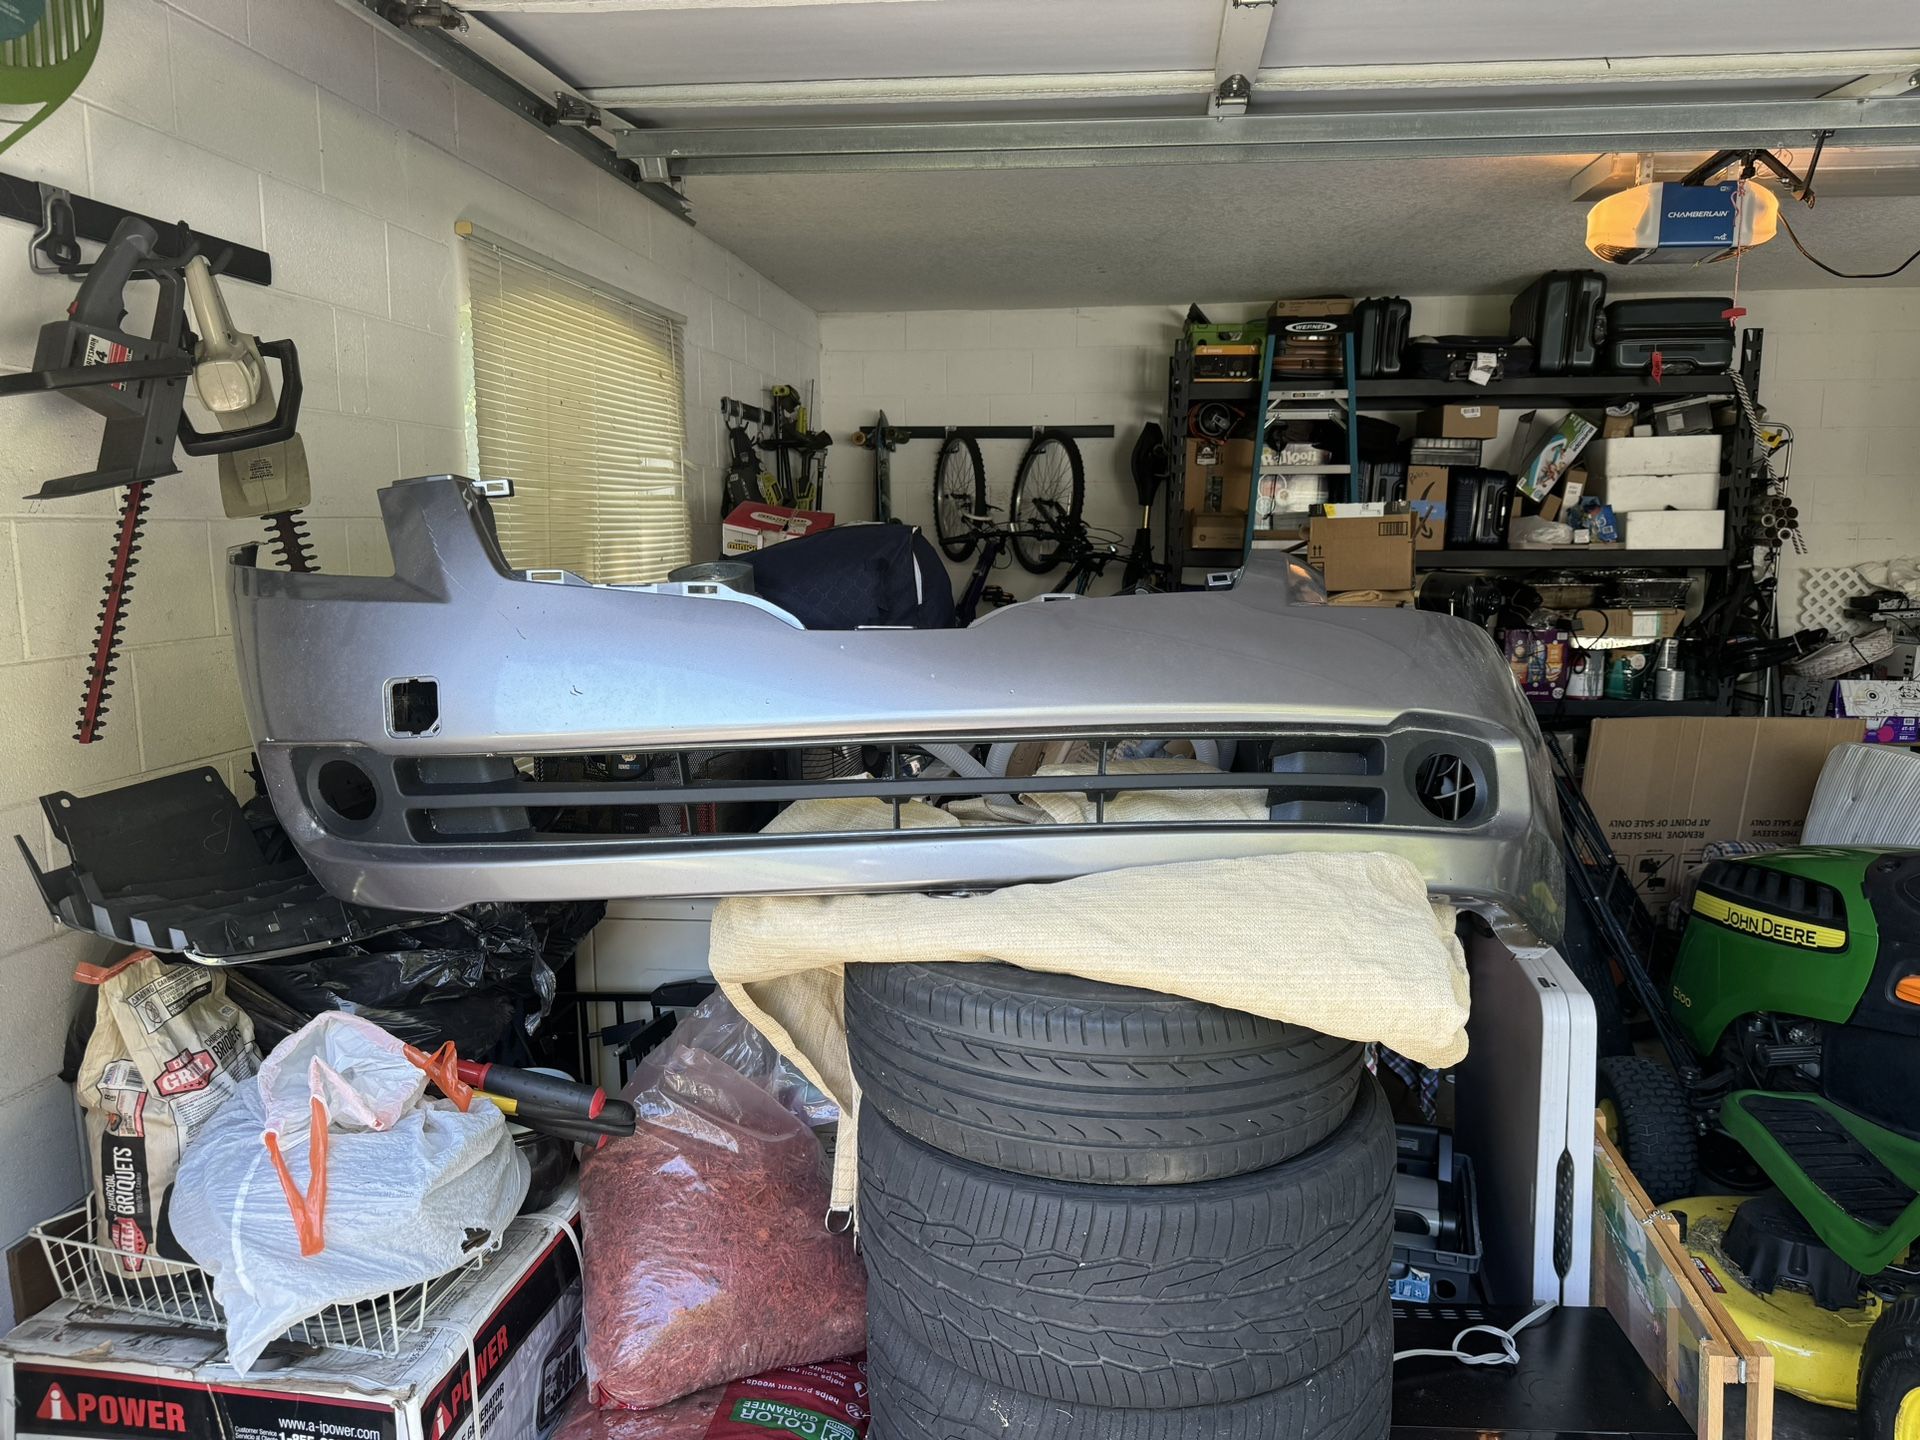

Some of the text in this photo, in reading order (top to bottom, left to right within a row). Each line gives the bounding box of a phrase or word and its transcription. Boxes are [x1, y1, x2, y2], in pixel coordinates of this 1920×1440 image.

[1667, 210, 1729, 219] CHAMBERLAIN
[1295, 323, 1328, 331] WERNER
[1608, 819, 1711, 828] AT POINT OF SALE ONLY
[1750, 819, 1772, 827] ONLY
[1773, 819, 1792, 827] SALE
[1610, 831, 1705, 840] REMOVE THIS SLEEVE
[1752, 830, 1779, 838] SLEEVE
[1722, 907, 1817, 945] JOHN DEERE
[162, 1057, 210, 1091] GRILL
[113, 1146, 136, 1215] BRIQUETS
[104, 1173, 116, 1212] CHARCOAL
[801, 1369, 818, 1379] soil
[808, 1365, 847, 1380] moisture
[820, 1374, 845, 1387] helps
[778, 1383, 814, 1394] prevent
[814, 1390, 840, 1405] helps
[743, 1400, 818, 1422] GUARANTEE
[740, 1407, 816, 1434] COLOR
[235, 1425, 258, 1434] Customer
[259, 1428, 277, 1437] Service
[278, 1417, 380, 1440] www.a-ipower.com
[828, 1421, 852, 1436] MONTH
[235, 1432, 255, 1440] Servicio
